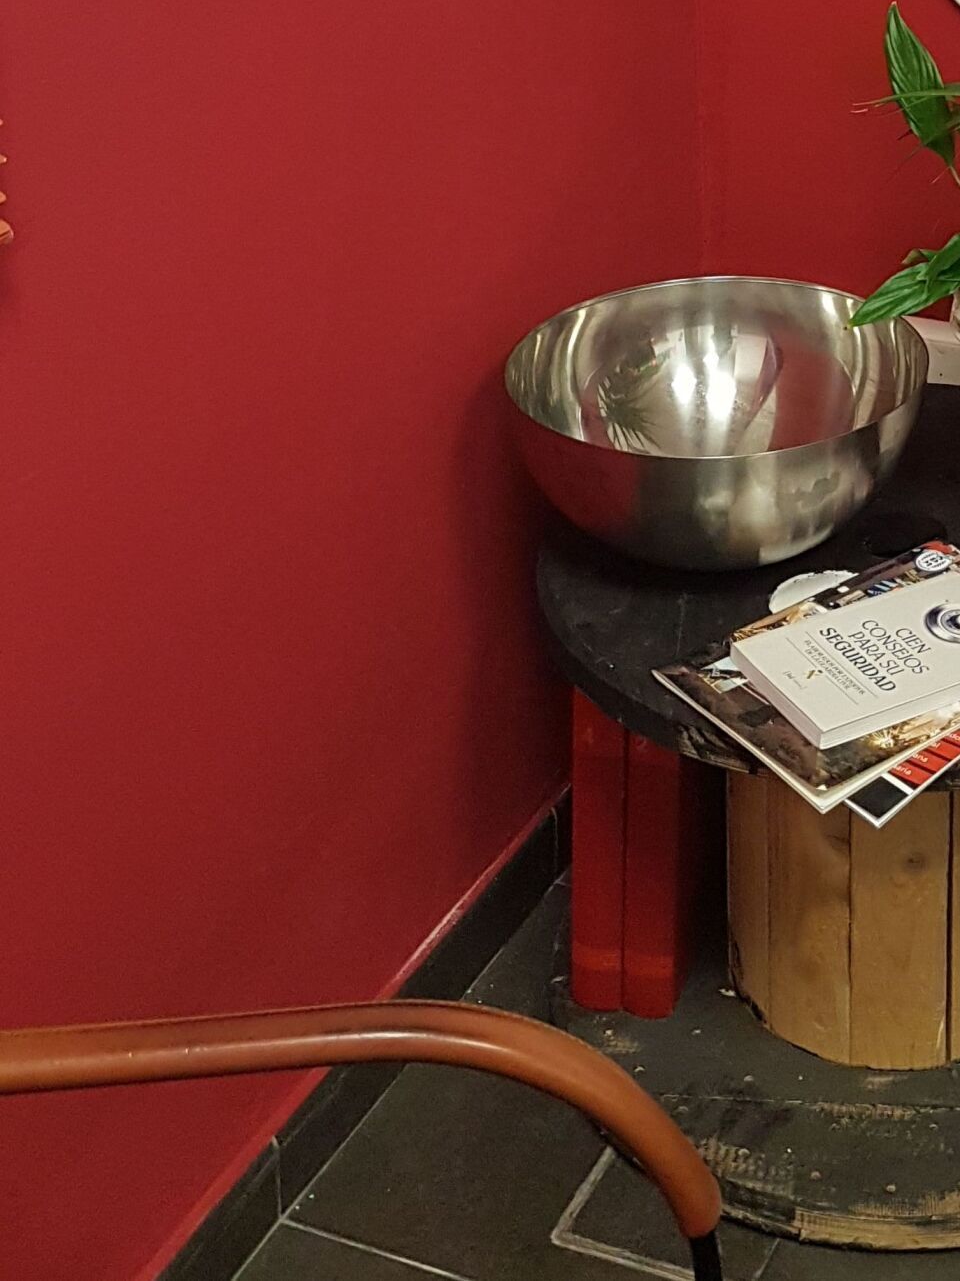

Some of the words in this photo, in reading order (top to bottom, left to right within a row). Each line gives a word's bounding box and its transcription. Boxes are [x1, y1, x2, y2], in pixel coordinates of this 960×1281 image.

[819, 626, 897, 692] SEGURIDAD
[848, 630, 886, 662] PARA
[879, 657, 905, 676] SU
[861, 619, 930, 675] CONSEJOS
[895, 627, 932, 654] CIEN
